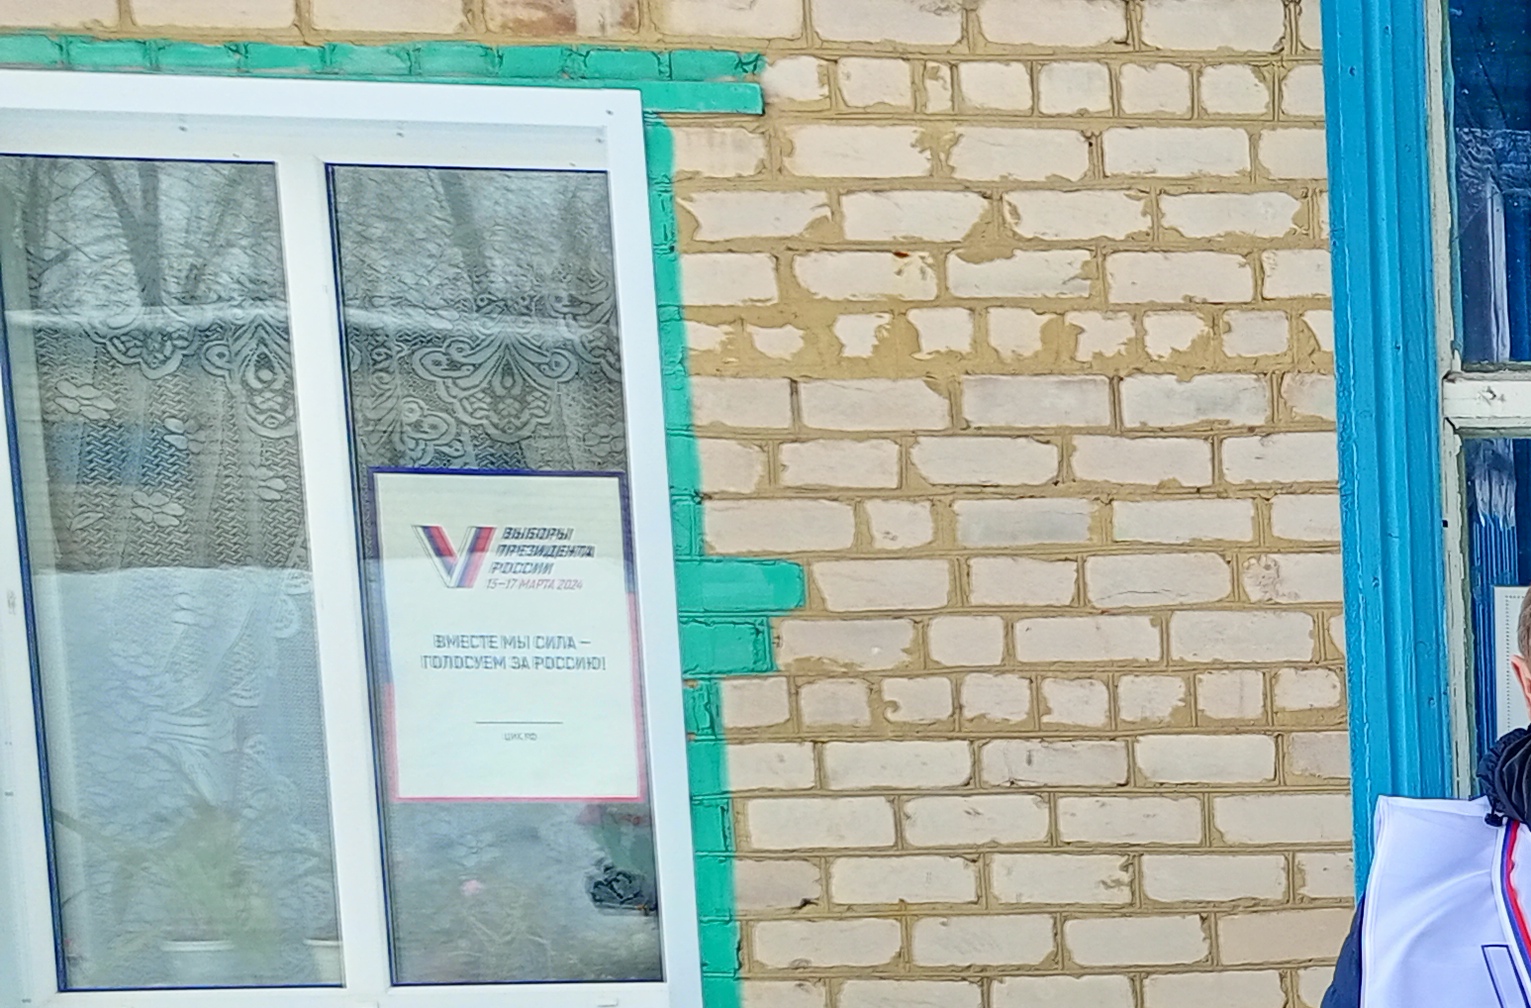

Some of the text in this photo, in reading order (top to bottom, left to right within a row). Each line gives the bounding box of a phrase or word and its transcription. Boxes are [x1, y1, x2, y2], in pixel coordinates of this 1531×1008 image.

[501, 527, 574, 540] ВЫБОРЫ
[495, 544, 595, 559] ПРЕЗИДЕНТА
[490, 562, 553, 574] РОССИИ
[518, 579, 554, 590] МАРТА
[556, 580, 583, 591] 2024
[433, 634, 498, 649] ВМЕСТЕ
[501, 635, 530, 649] МЫ
[534, 636, 577, 650] СИЛА
[421, 655, 606, 671] ГОЛОСУЕМ ЗА РОССИЮ!
